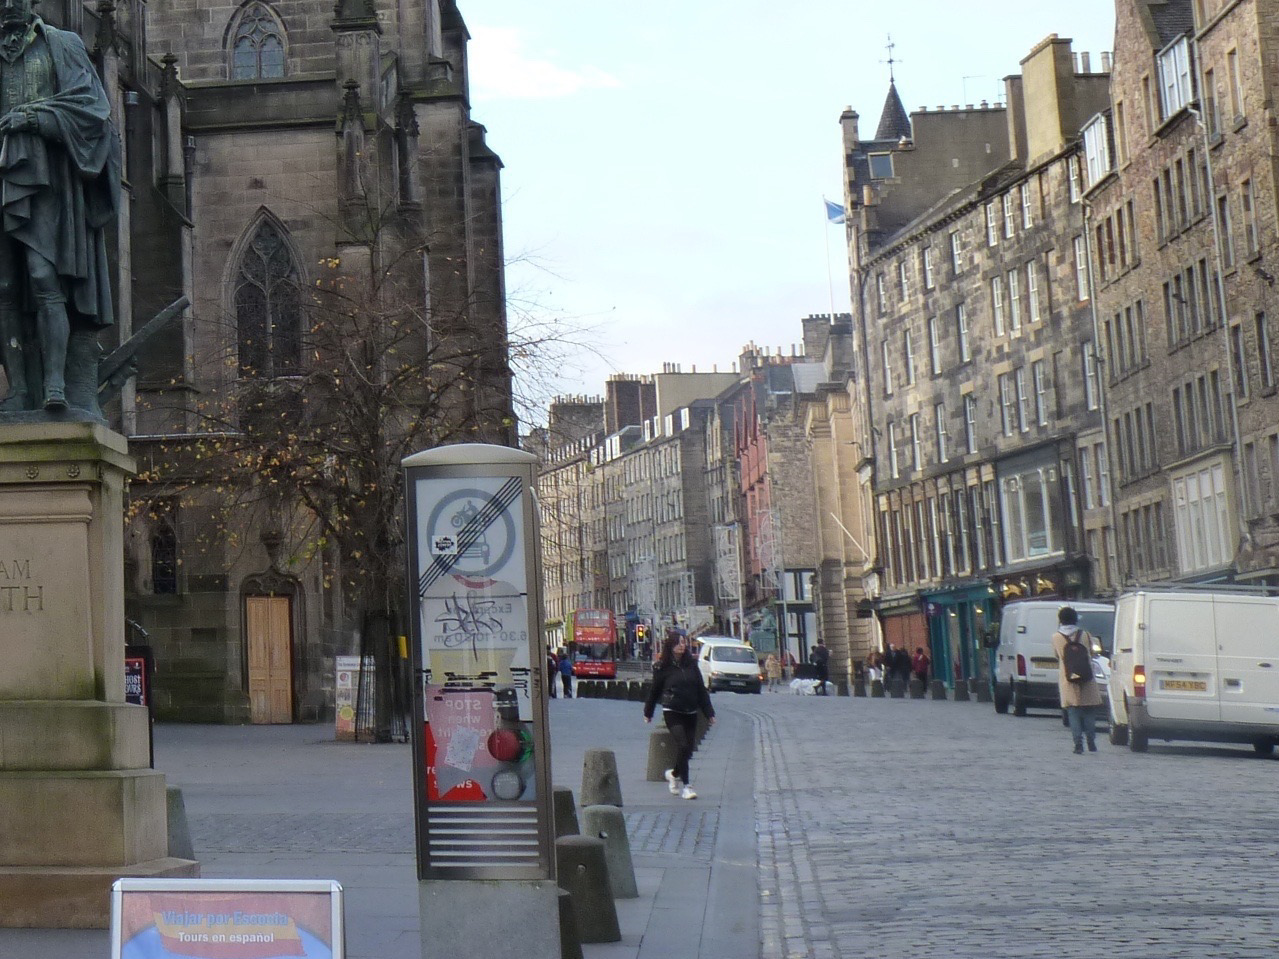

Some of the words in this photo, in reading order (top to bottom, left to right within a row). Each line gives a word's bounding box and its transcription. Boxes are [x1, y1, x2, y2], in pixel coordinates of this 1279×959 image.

[162, 910, 204, 927] Viajar
[207, 916, 230, 928] por
[232, 911, 289, 926] Escocia
[178, 932, 209, 942] Tours
[211, 934, 226, 942] en
[229, 932, 274, 945] español
